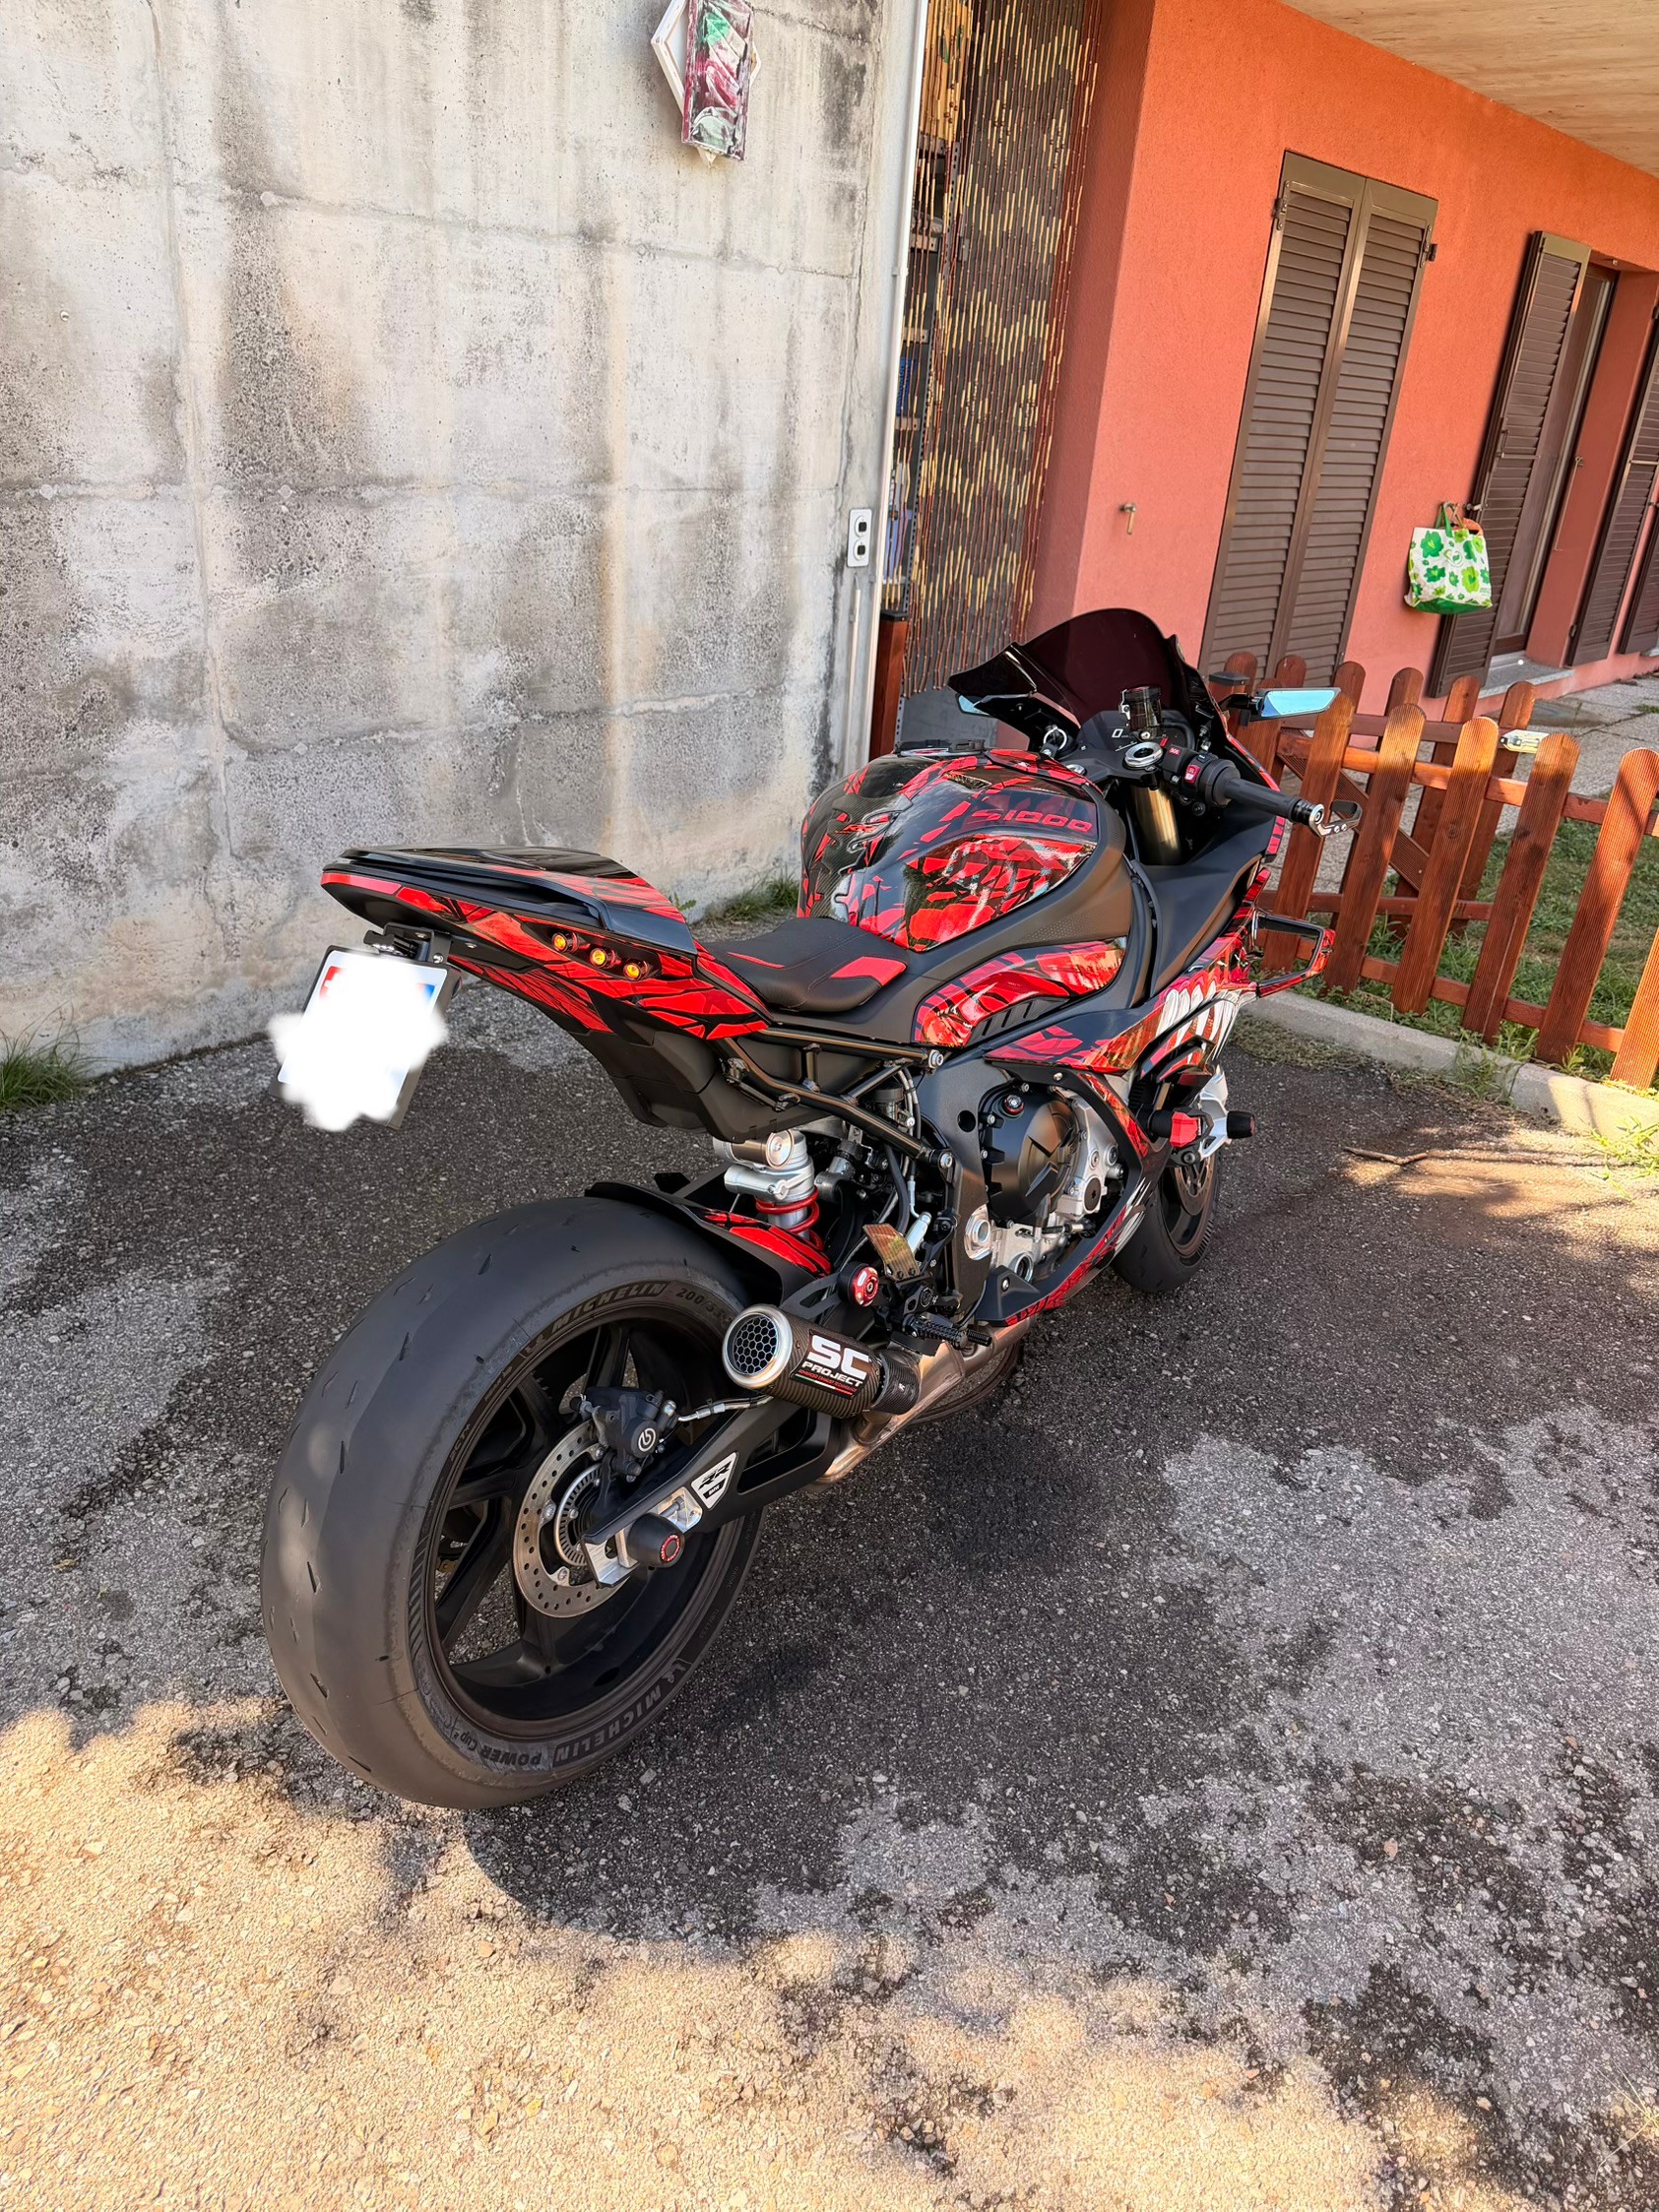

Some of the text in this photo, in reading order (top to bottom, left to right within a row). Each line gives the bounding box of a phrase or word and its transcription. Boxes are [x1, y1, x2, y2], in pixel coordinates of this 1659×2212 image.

[971, 809, 1092, 833] S1000
[551, 1282, 669, 1335] MICHELIN
[801, 1360, 863, 1387] PROJECT
[807, 1334, 870, 1381] SC
[554, 1684, 663, 1763] MICHELIN
[479, 1745, 542, 1766] POWER
